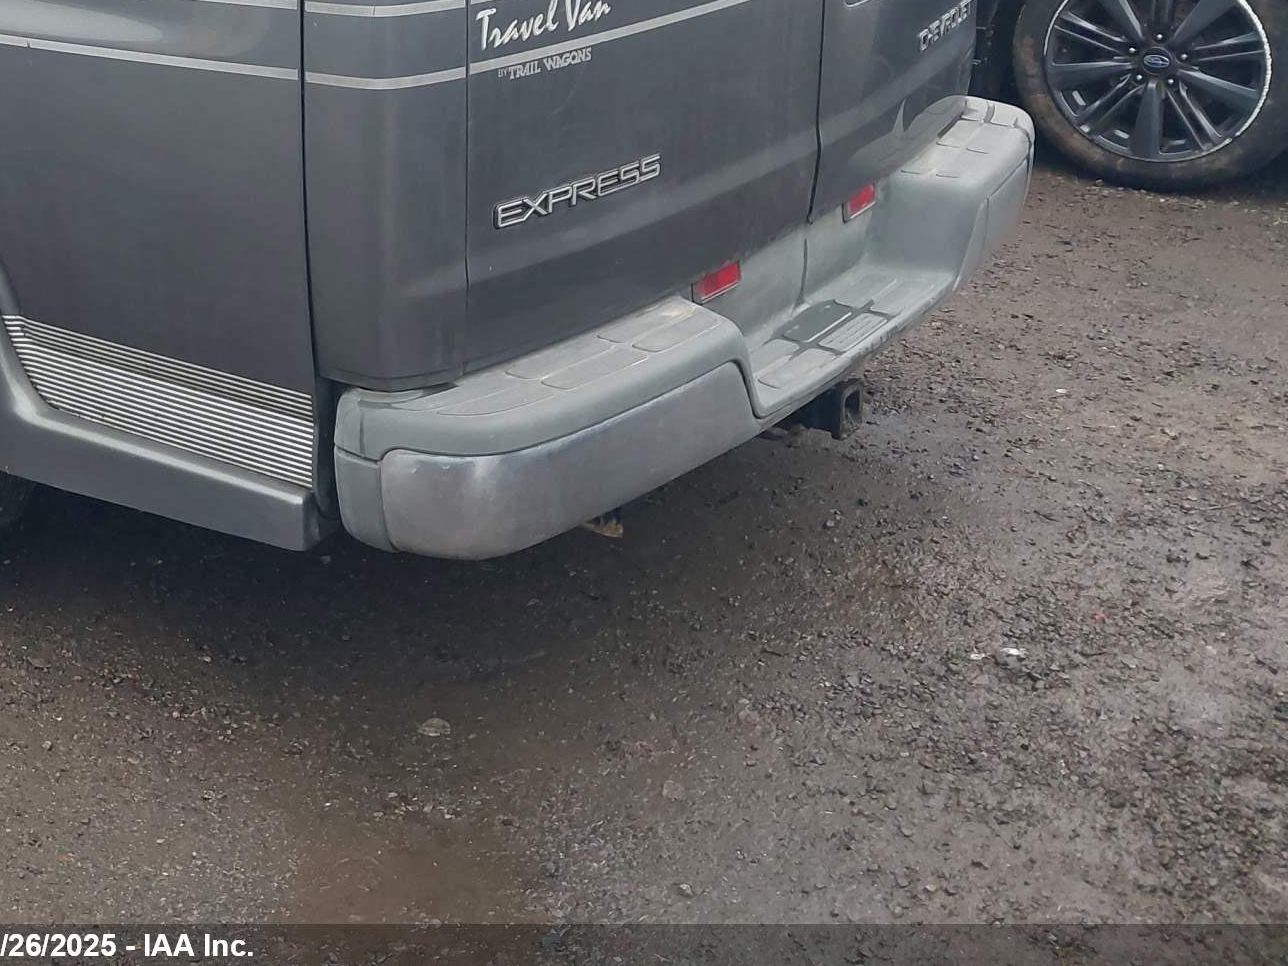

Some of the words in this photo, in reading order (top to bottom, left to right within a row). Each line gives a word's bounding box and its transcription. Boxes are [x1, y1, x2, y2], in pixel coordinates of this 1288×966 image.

[508, 60, 541, 79] TRAIL
[542, 47, 592, 71] WAGONS
[494, 153, 661, 229] EXPRESS
